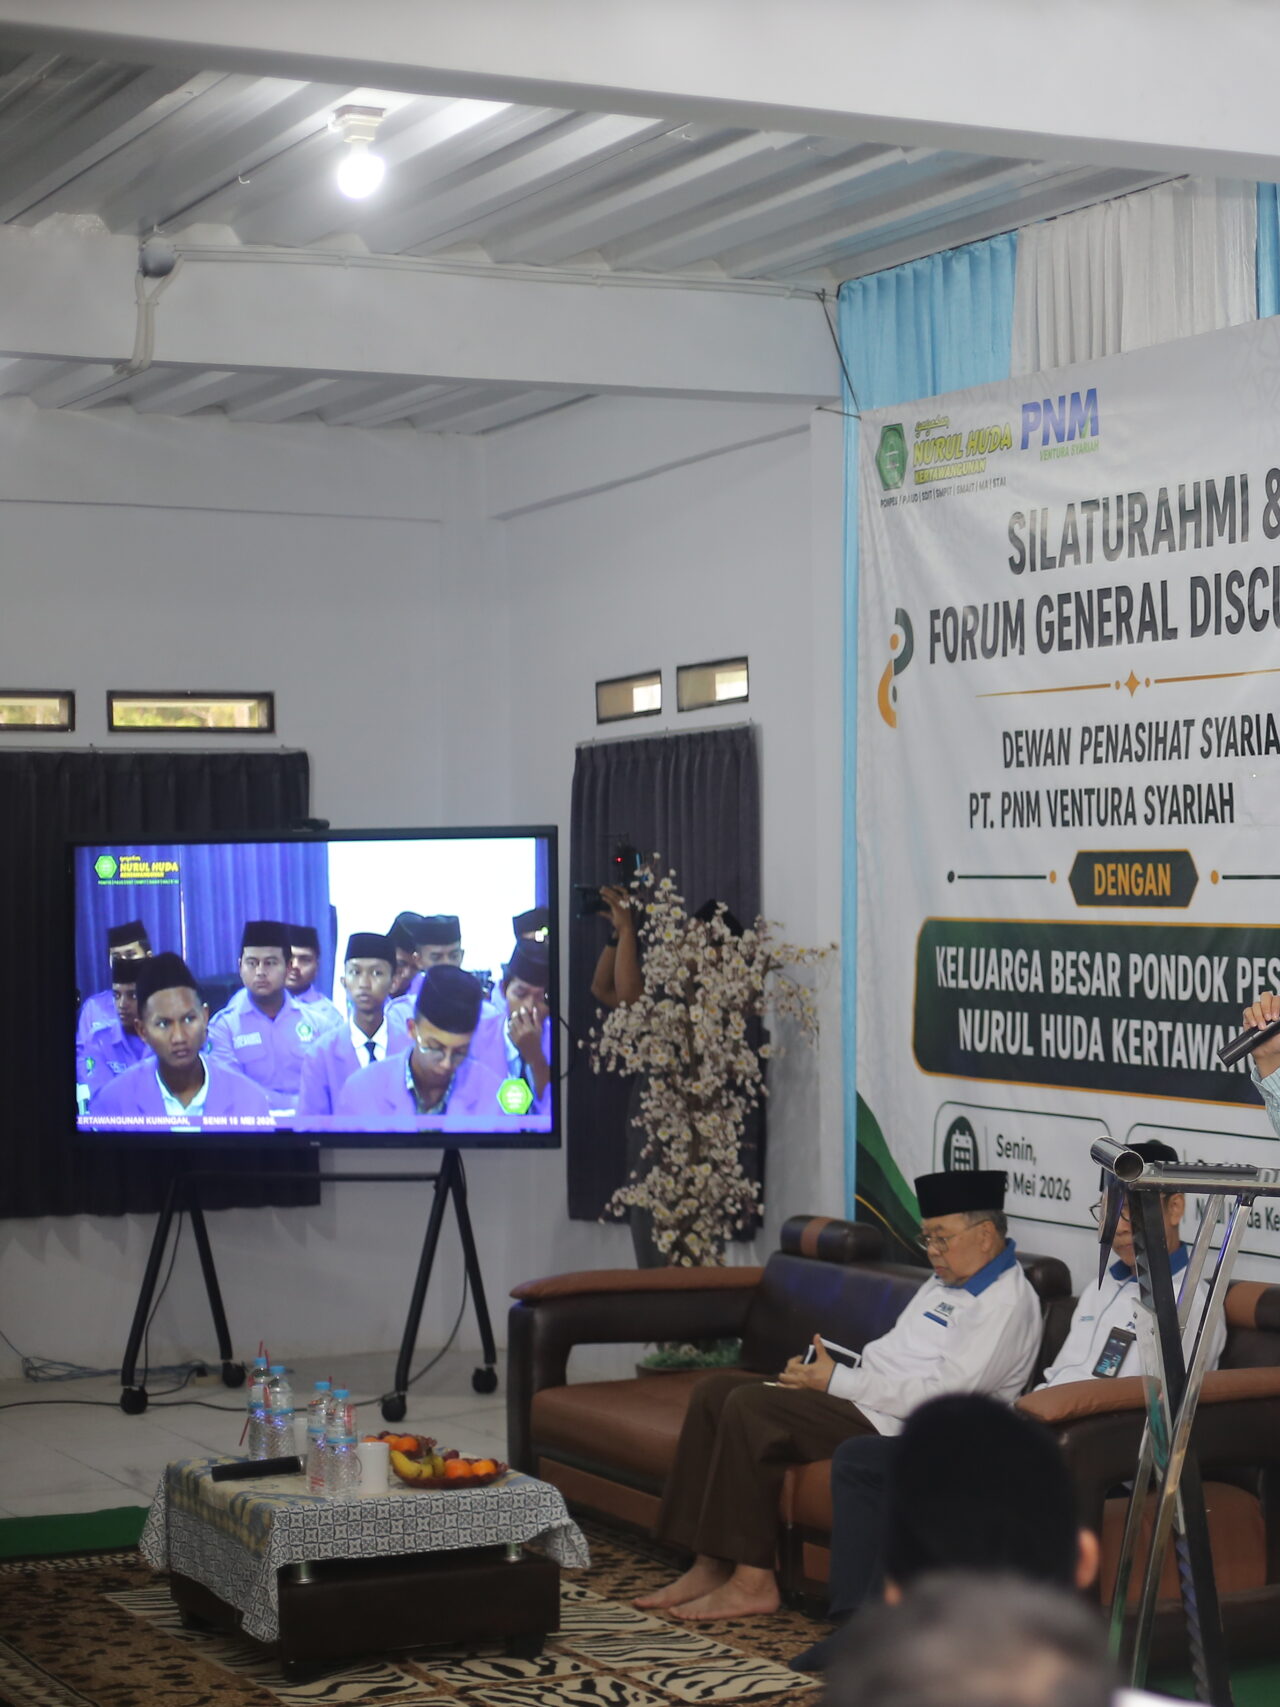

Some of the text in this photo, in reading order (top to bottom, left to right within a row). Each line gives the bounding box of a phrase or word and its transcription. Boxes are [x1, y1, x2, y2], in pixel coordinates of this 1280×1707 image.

[1021, 388, 1099, 450] PNM
[913, 432, 963, 468] NURUL
[966, 422, 1013, 457] HUDA
[1040, 440, 1100, 461] VENTURA SYARIAH
[1007, 474, 1249, 576] SILATURAHMI
[929, 598, 1026, 664] FORUM
[1035, 573, 1178, 655] GENERAL
[1002, 723, 1071, 769] DEWAN
[1079, 719, 1195, 767] PENASIHAT
[969, 781, 1235, 829] PT. PNM VENTURA SYARIAH
[1093, 863, 1172, 897] DENGAN
[935, 945, 1045, 993] KELUARGA
[1050, 950, 1121, 998] BESAR
[1128, 953, 1229, 1004] PONDOK
[958, 1008, 1034, 1057] NURUL
[1040, 1013, 1105, 1062] HUDA
[996, 1133, 1037, 1166] Senin,
[1013, 1171, 1036, 1197] Mei
[1040, 1175, 1071, 1202] 2026
